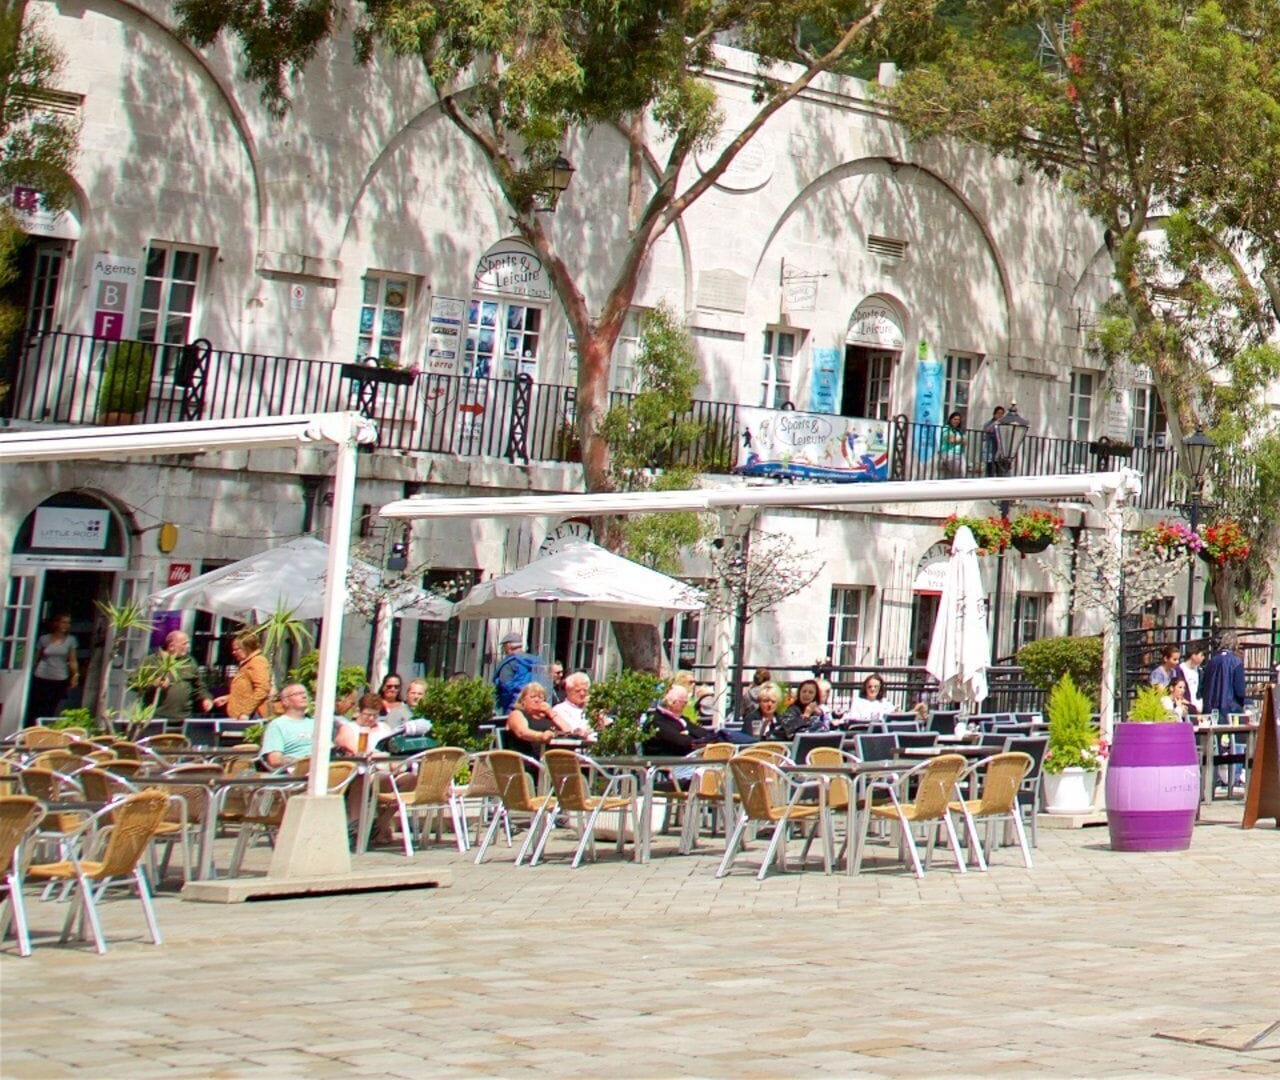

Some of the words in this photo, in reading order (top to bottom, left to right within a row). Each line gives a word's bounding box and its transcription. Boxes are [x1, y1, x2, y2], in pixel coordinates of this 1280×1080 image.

[95, 261, 138, 276] Agents
[104, 285, 119, 306] B
[102, 316, 115, 337] F
[170, 566, 190, 583] illy
